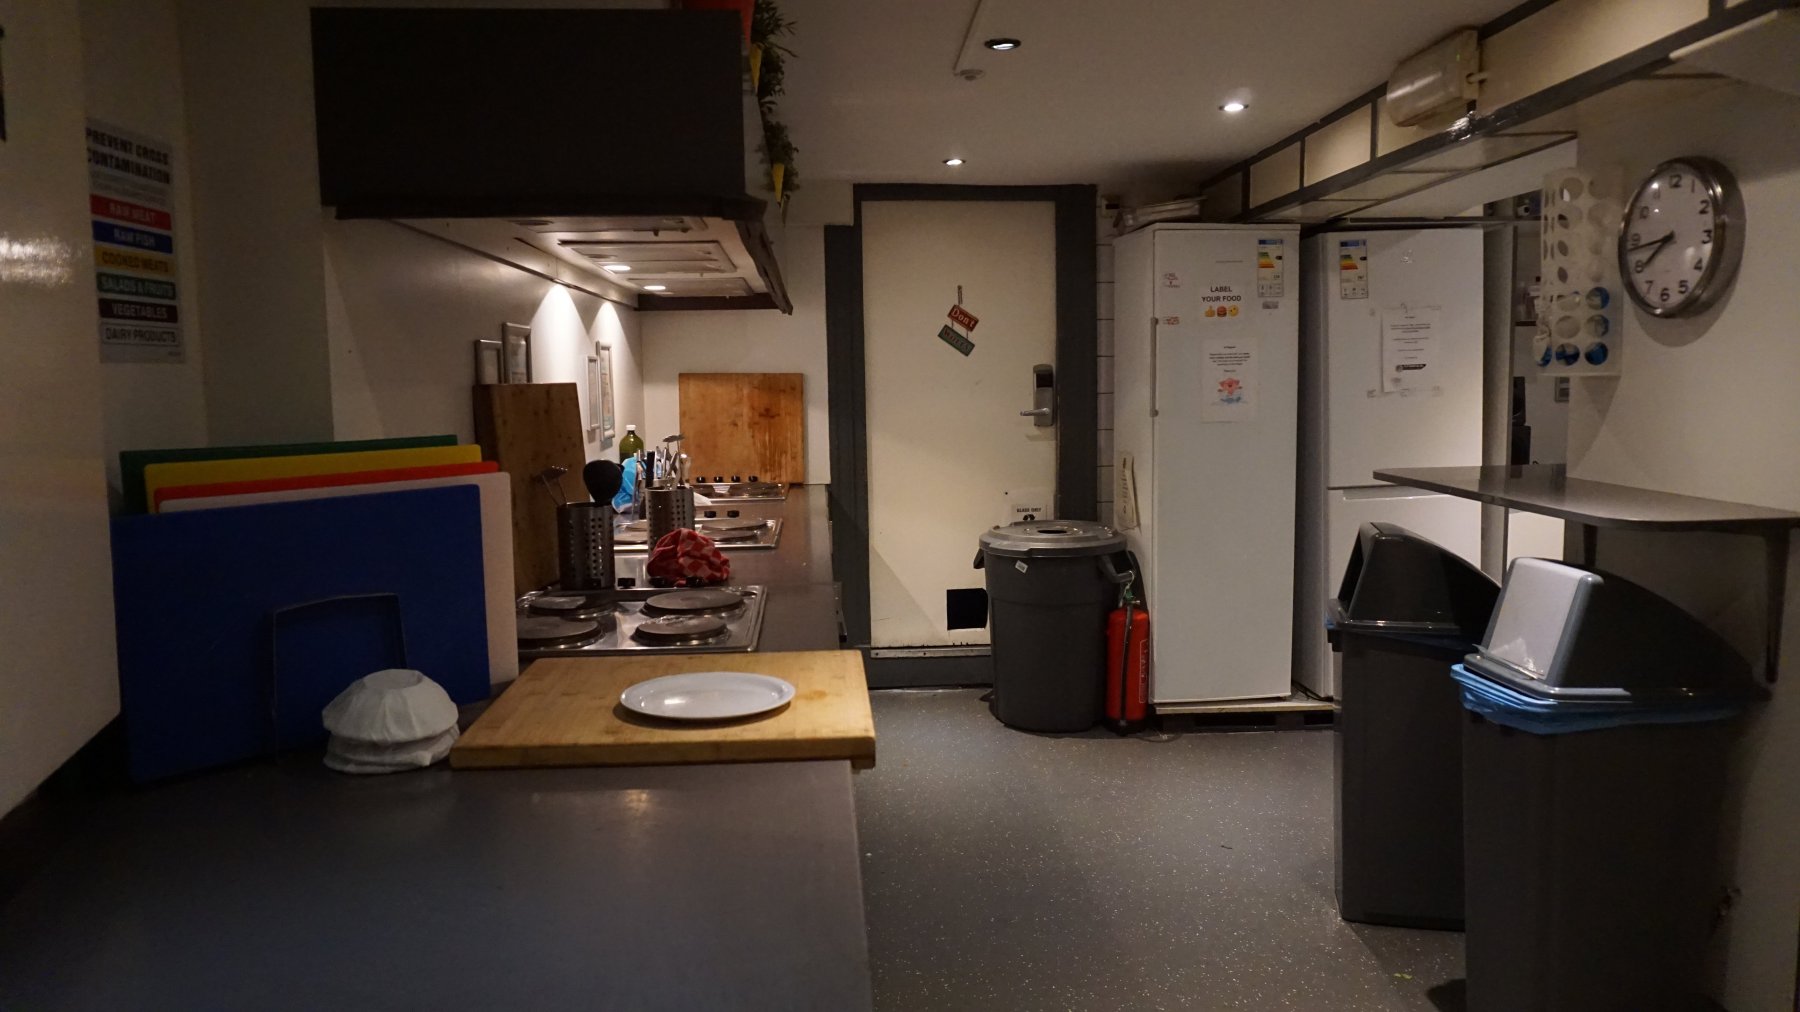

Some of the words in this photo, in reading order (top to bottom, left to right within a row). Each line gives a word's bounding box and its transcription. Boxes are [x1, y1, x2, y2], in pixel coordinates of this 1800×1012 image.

[85, 127, 133, 155] PREVENT
[136, 144, 169, 166] CROSS
[1669, 174, 1682, 188] 12
[1690, 178, 1696, 193] 1
[109, 202, 130, 218] RAW
[133, 207, 156, 223] MEAT
[1699, 200, 1710, 214] 2
[113, 228, 133, 243] RAW
[136, 232, 156, 248] FISH
[1630, 233, 1641, 246] 9
[1702, 230, 1712, 244] 3
[141, 257, 169, 273] MEATS
[1634, 260, 1645, 274] 8
[1694, 258, 1703, 271] 4
[101, 276, 136, 292] SALADS
[145, 281, 174, 297] FRUITS
[1645, 280, 1654, 294] 7
[1678, 280, 1690, 294] 5
[1660, 287, 1670, 302] 6
[112, 302, 168, 320] VEGETABLES
[105, 327, 131, 341] DAIRY
[133, 328, 176, 343] PRODUCTS
